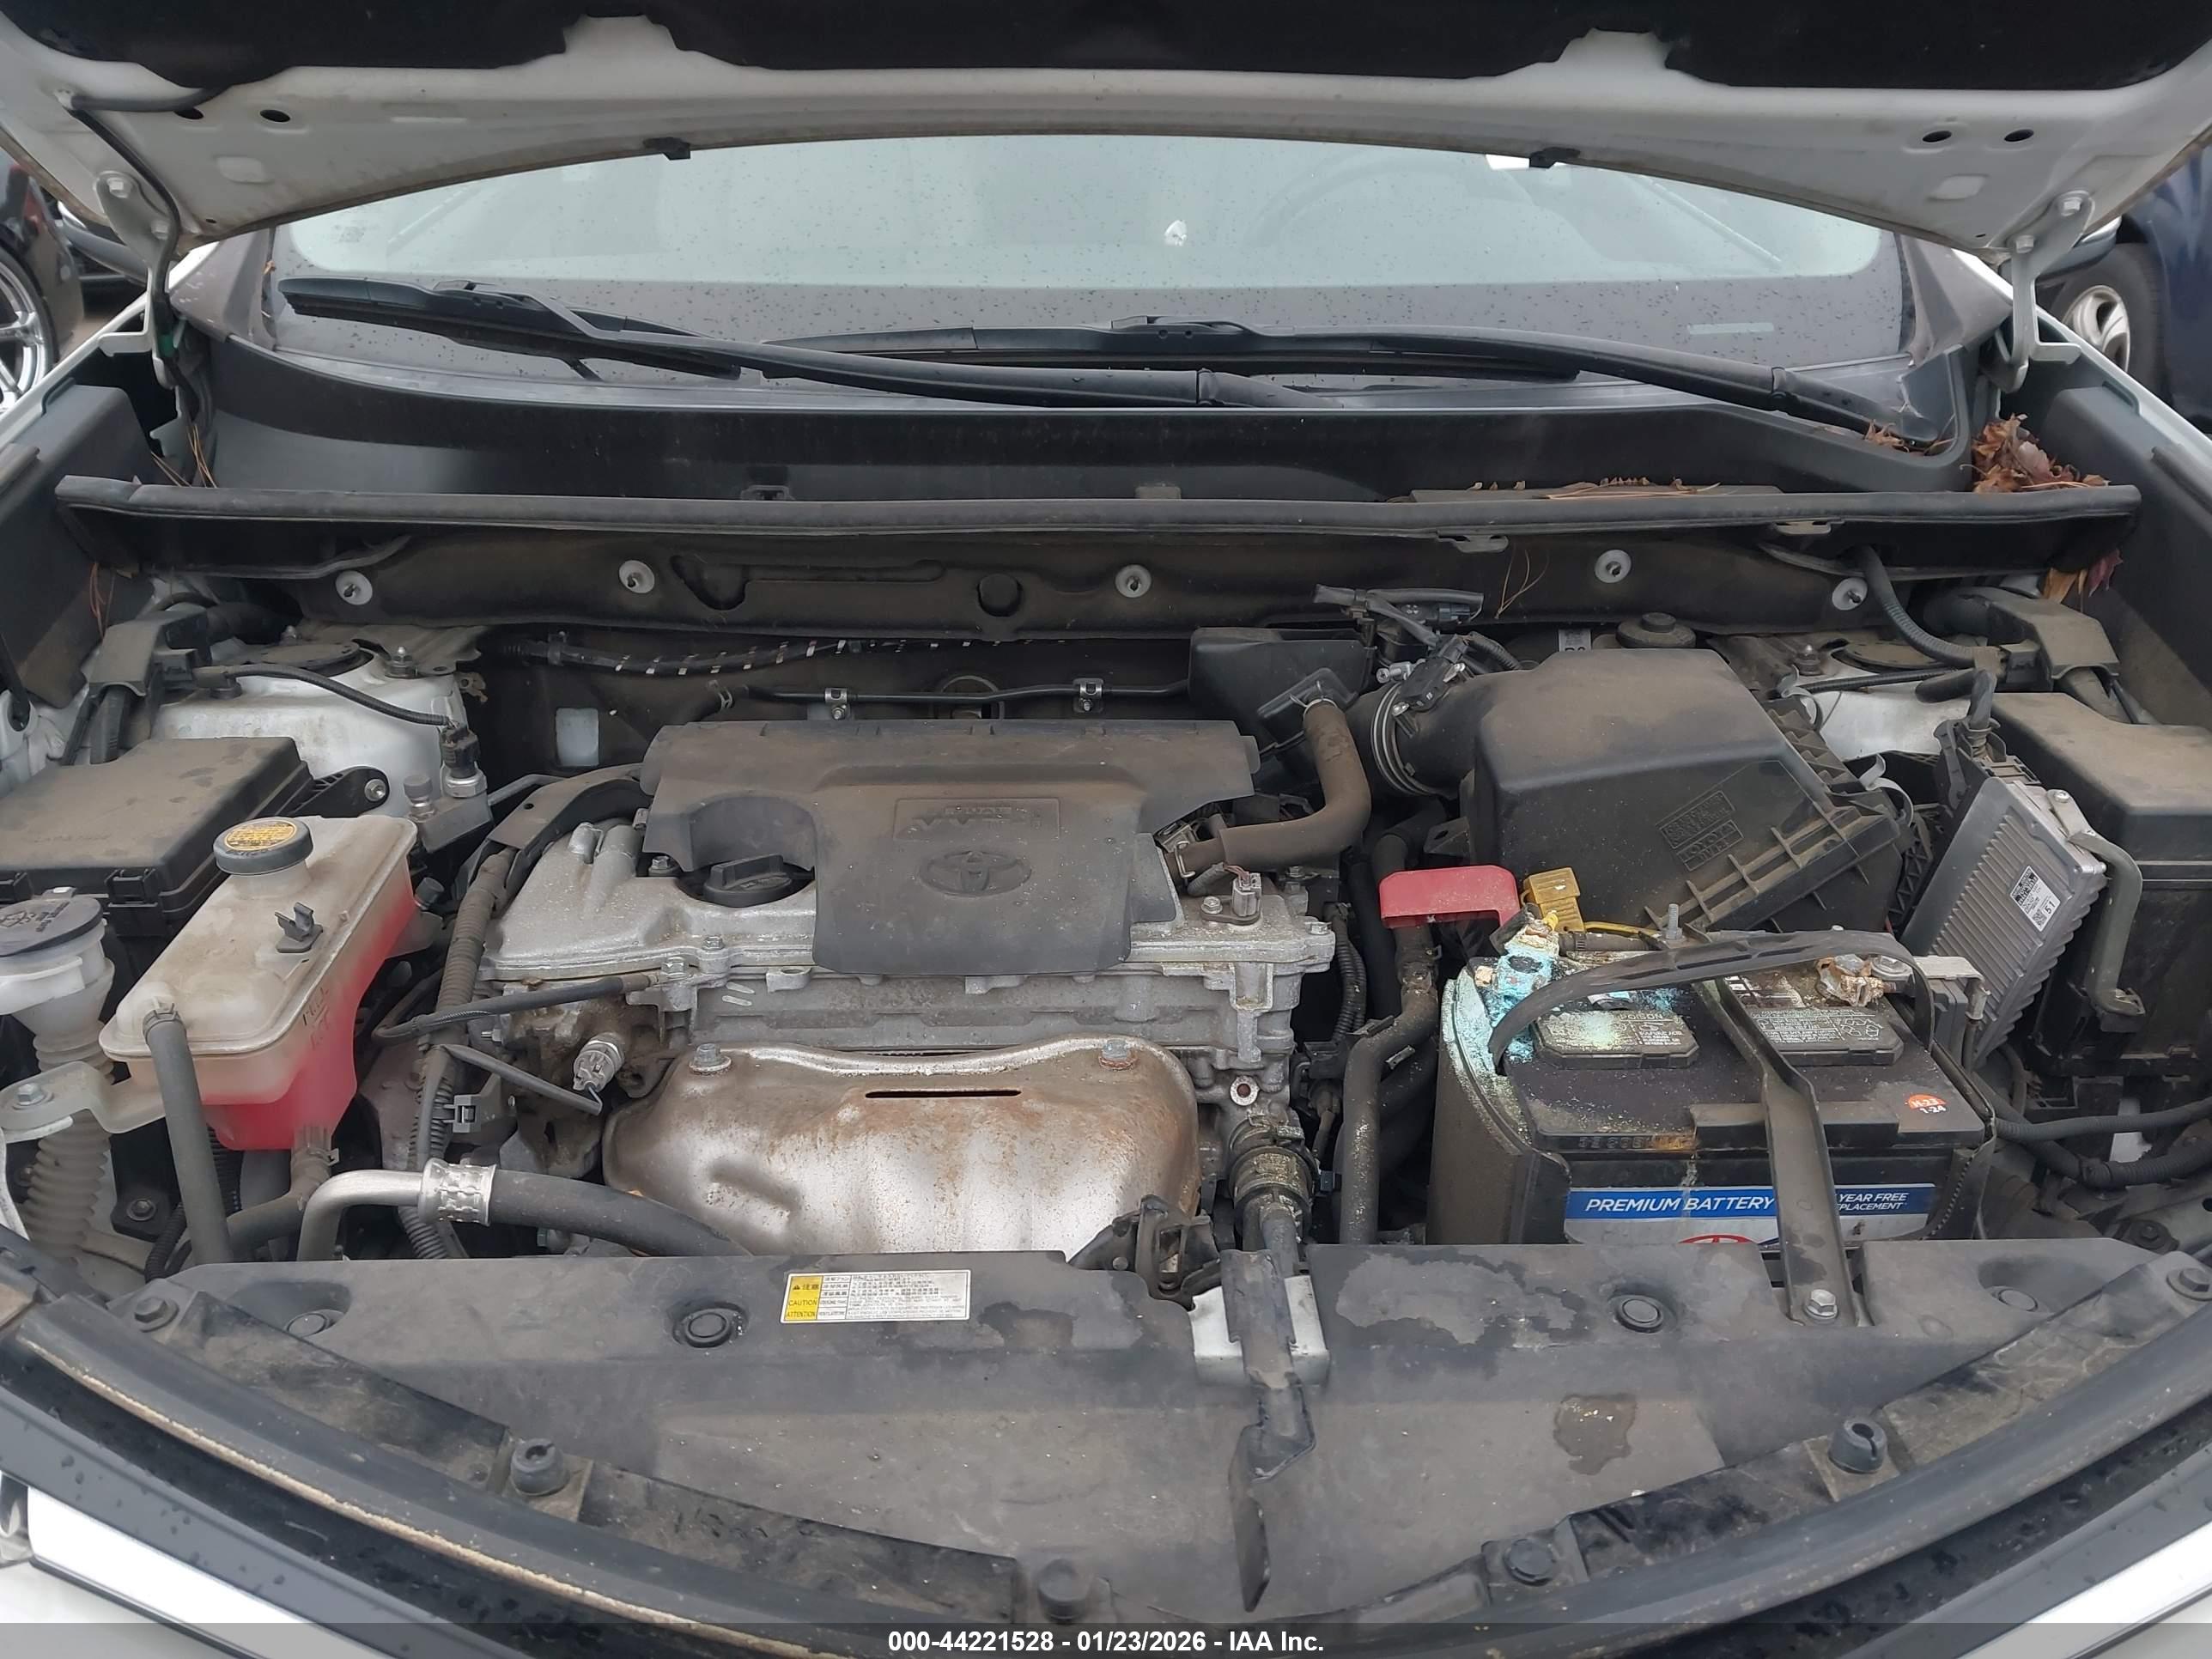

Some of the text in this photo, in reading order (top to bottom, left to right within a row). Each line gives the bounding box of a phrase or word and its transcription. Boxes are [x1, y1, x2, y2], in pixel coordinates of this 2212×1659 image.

[2044, 901, 2056, 915] 51
[1585, 1196, 1775, 1212] PREMIUM BATTERY
[1839, 1193, 1910, 1202] YEAR FREE
